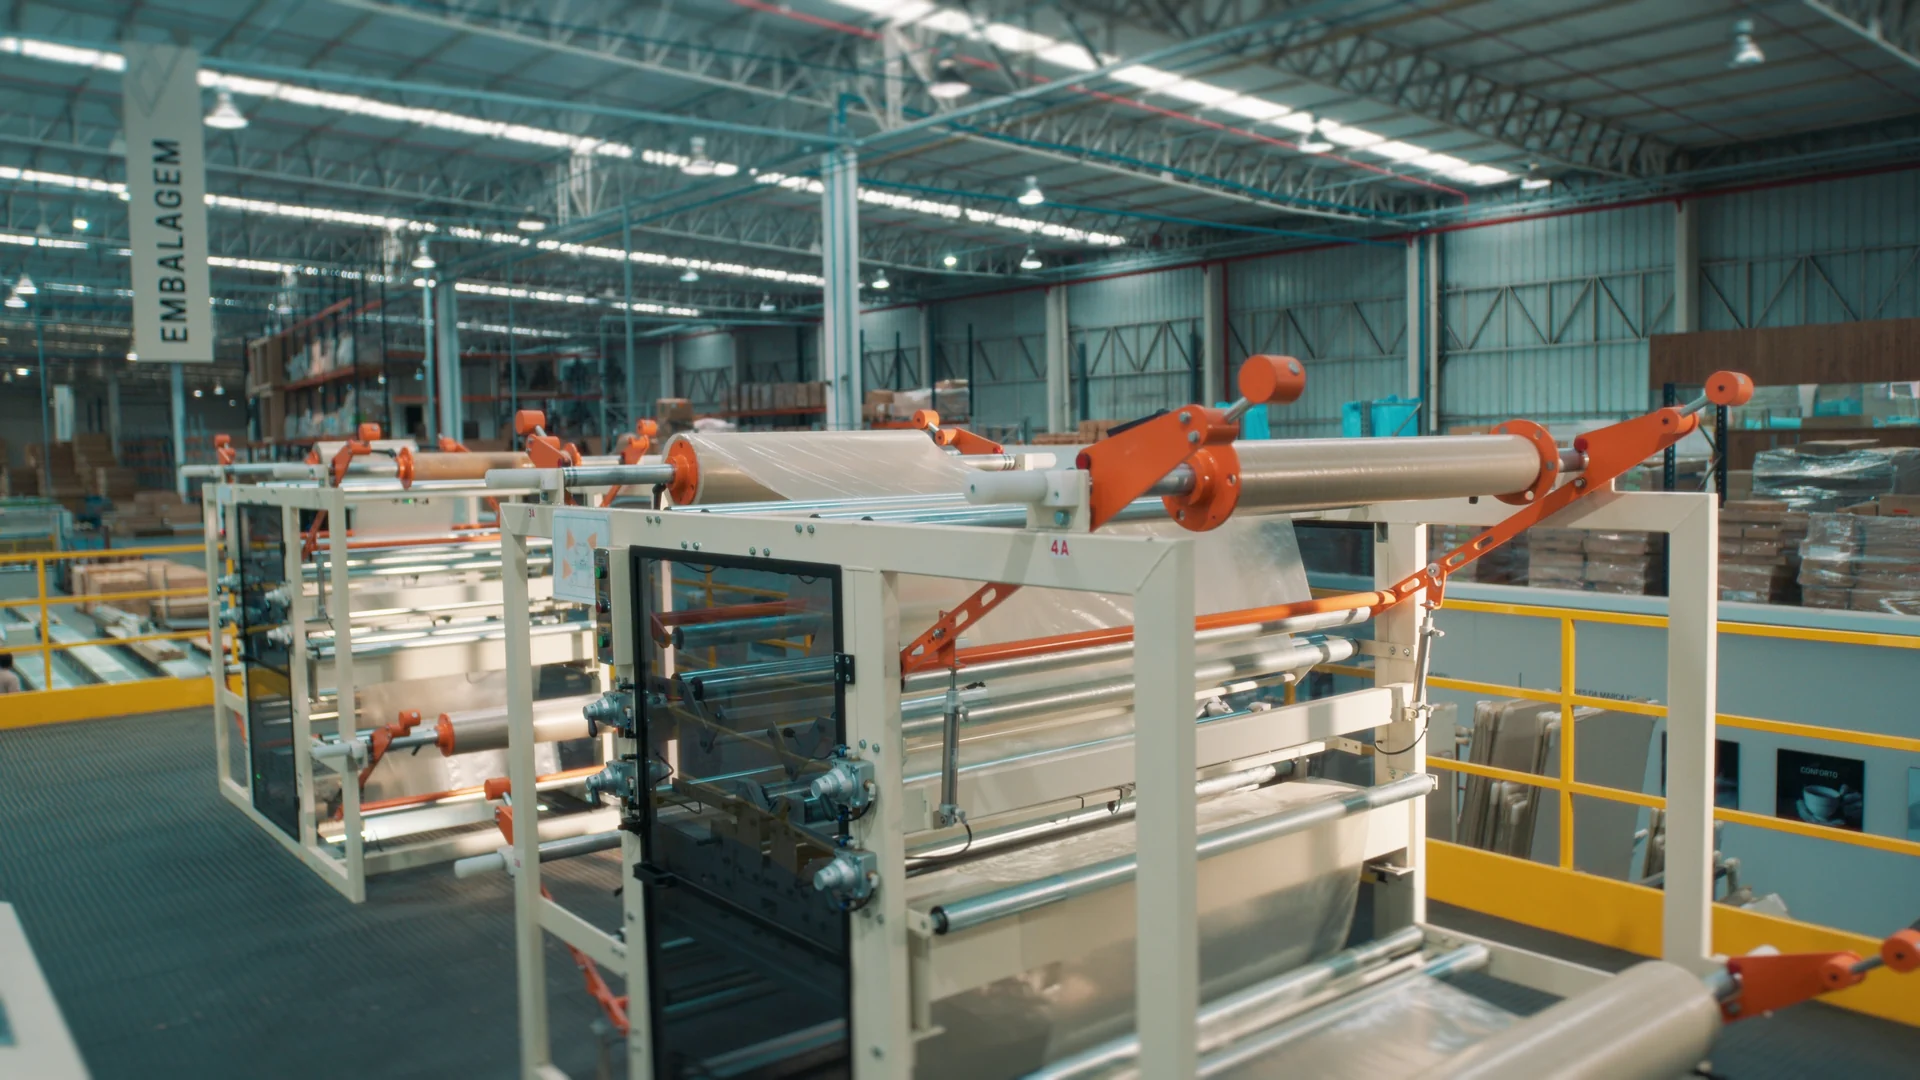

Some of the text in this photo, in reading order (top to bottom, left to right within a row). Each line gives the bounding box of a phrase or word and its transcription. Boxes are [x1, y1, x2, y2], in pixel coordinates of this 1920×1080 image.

[152, 138, 188, 343] EMBALAGEM
[528, 508, 536, 518] 3A
[1050, 539, 1069, 556] 4A
[1800, 766, 1838, 779] CONFORTO
